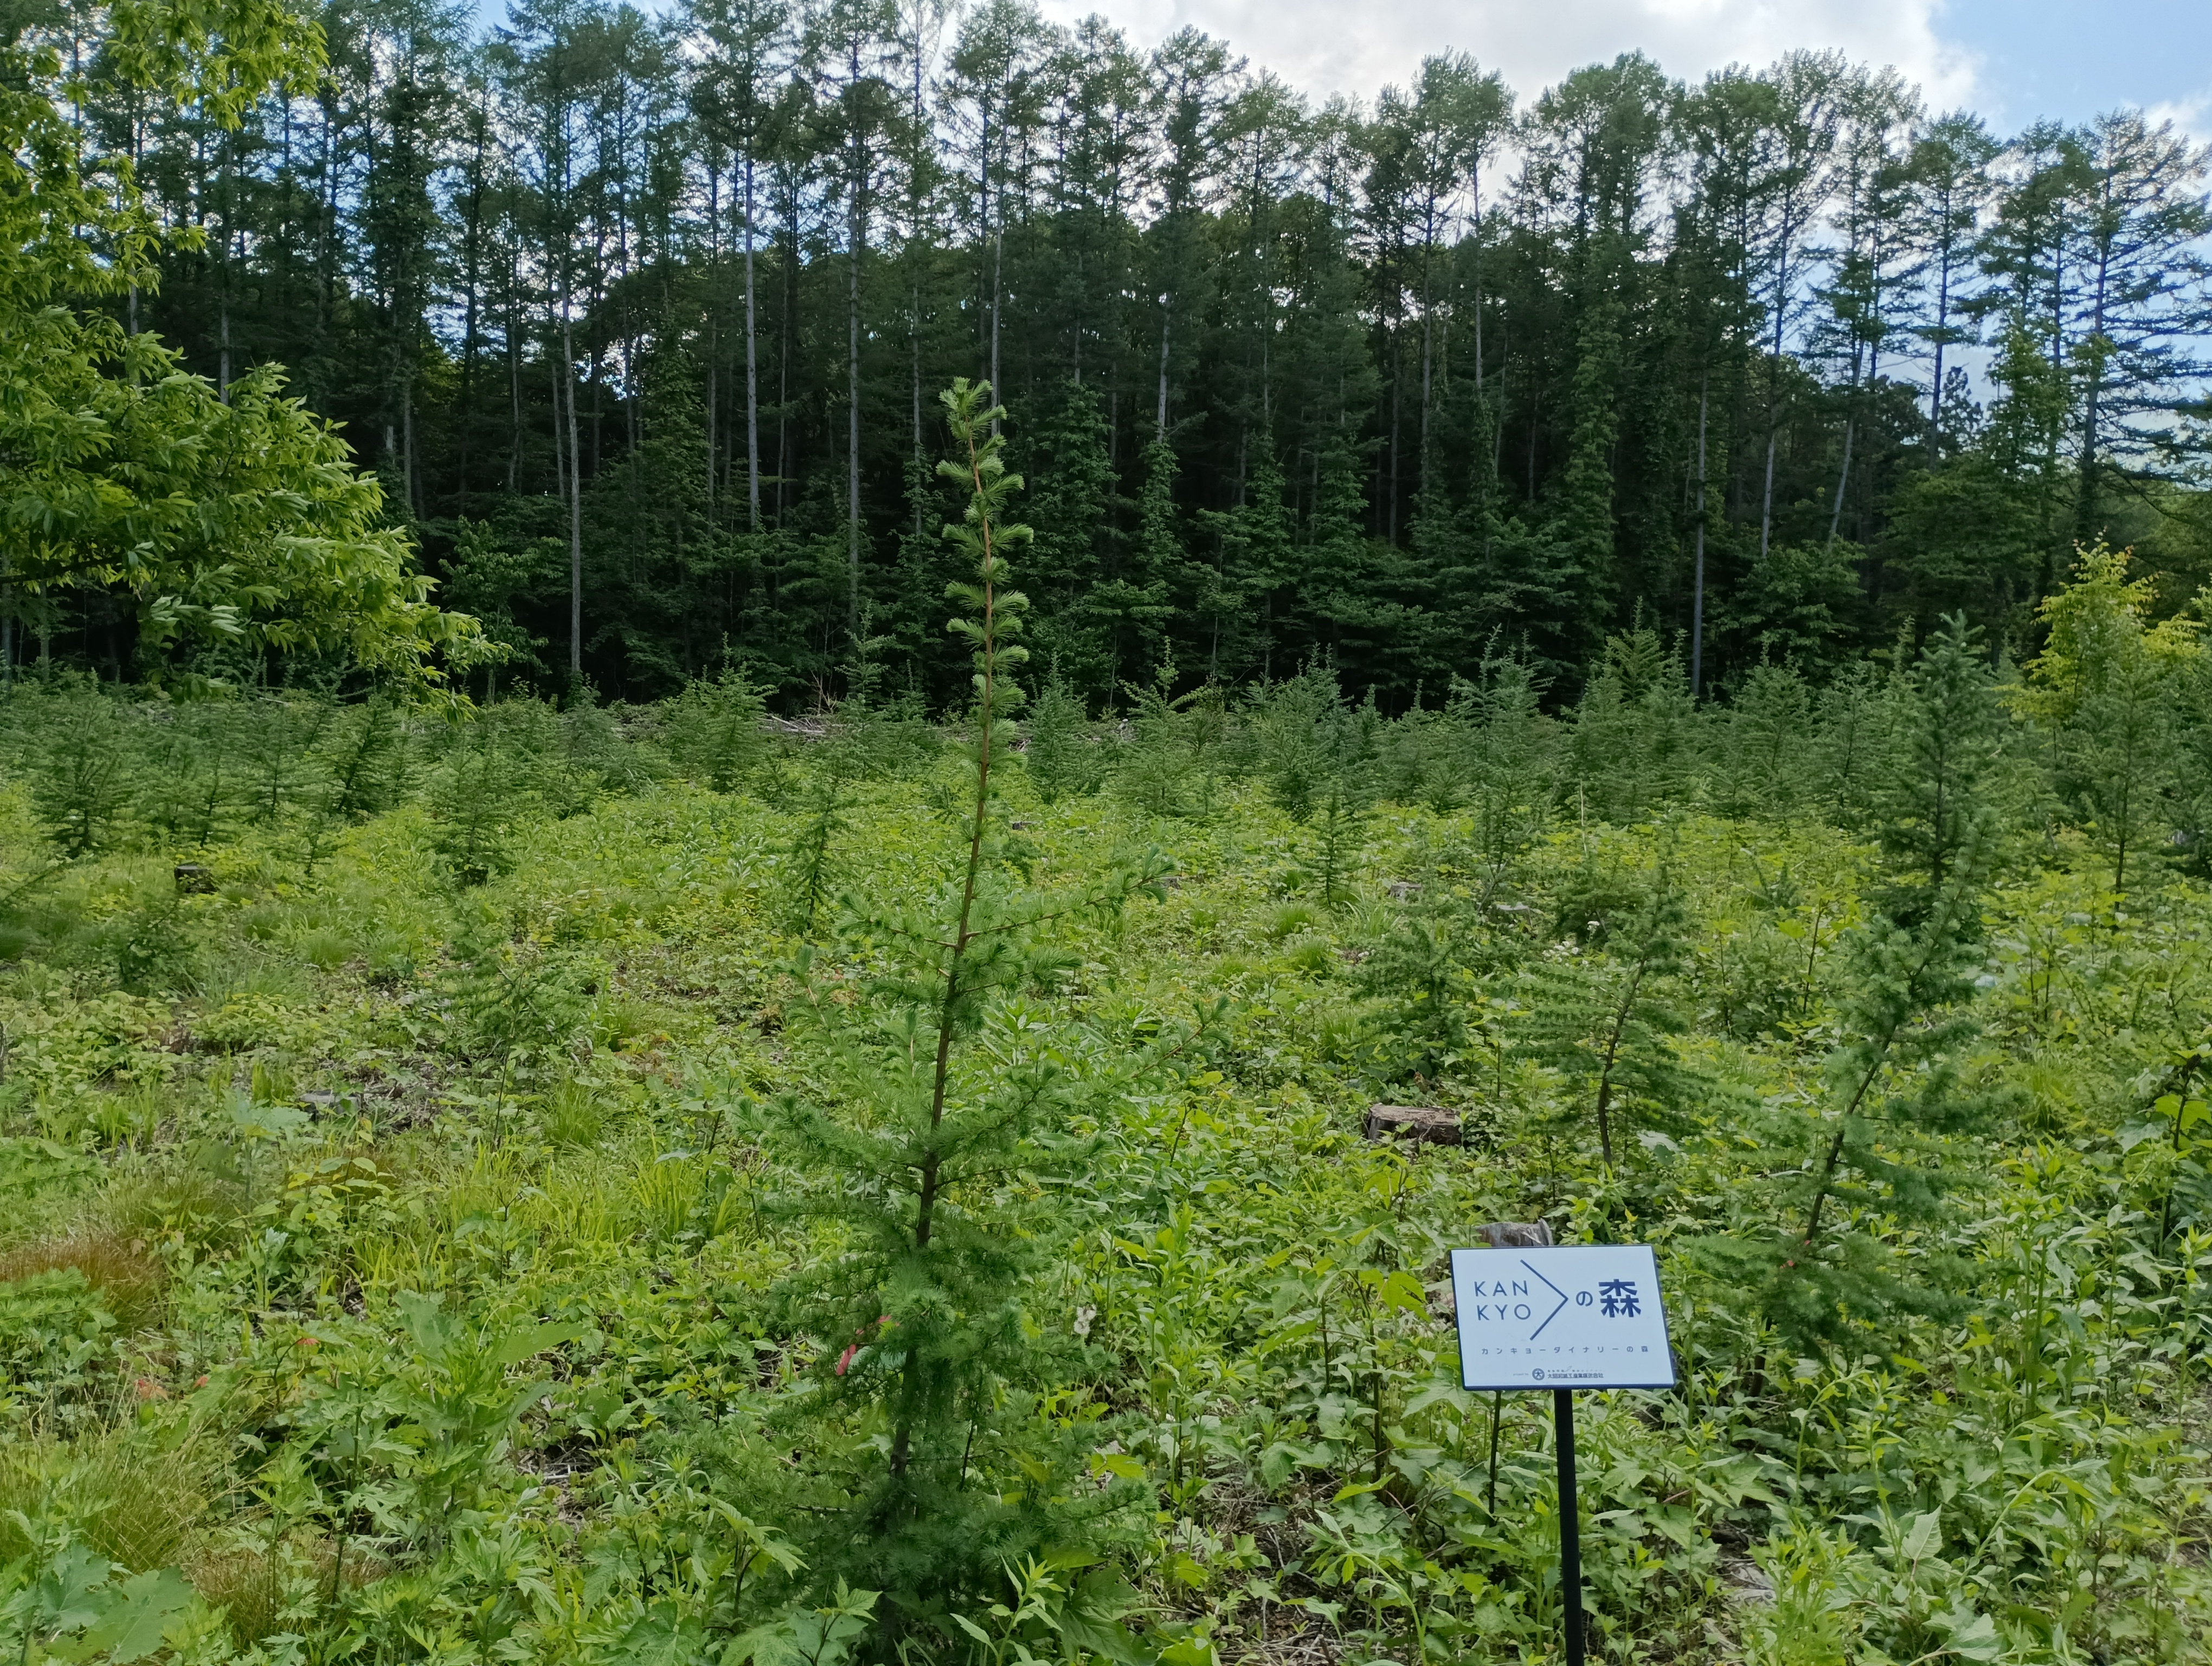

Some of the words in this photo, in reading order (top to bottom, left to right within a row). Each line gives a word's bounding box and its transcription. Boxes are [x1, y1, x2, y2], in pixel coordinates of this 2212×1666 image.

[1474, 1280, 1528, 1297] KAN
[1576, 1279, 1642, 1318] の森
[1477, 1304, 1531, 1321] KYO
